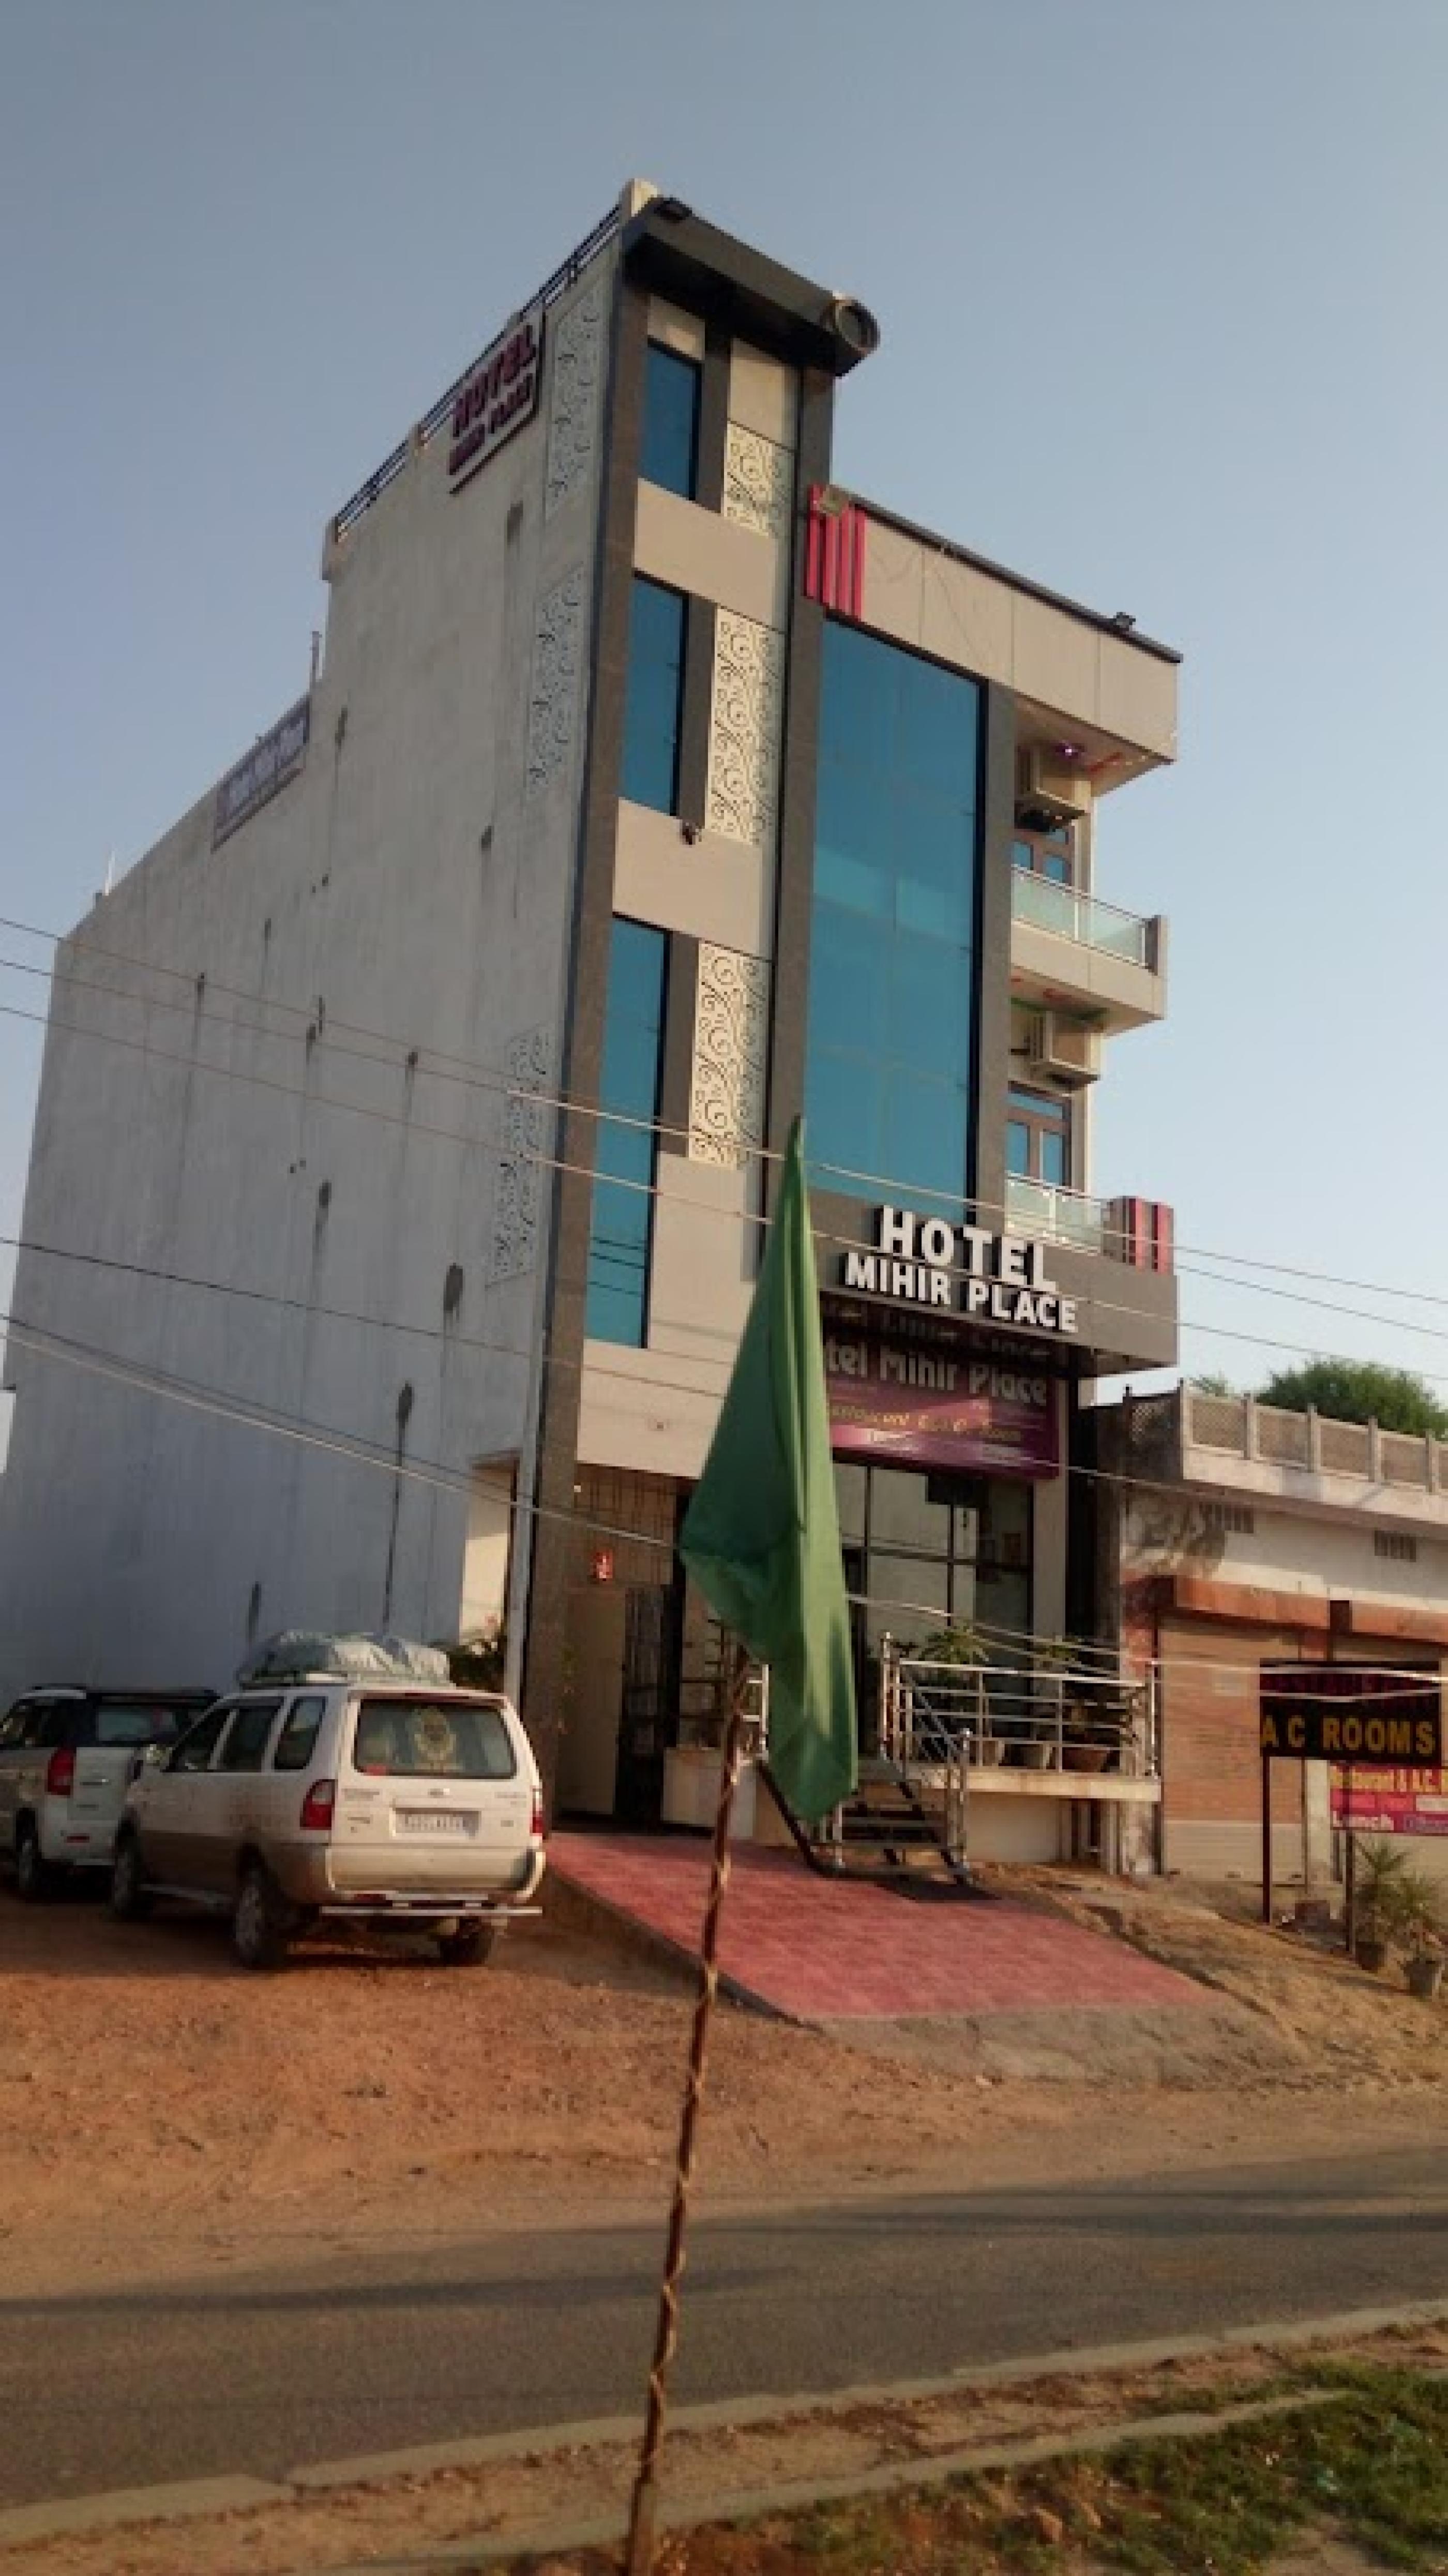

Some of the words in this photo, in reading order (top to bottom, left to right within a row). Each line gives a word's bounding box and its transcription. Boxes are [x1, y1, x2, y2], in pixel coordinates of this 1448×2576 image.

[881, 1205, 1057, 1292] HOTEL
[844, 1251, 951, 1305] MIHIR
[969, 1279, 1078, 1332] PLACE
[826, 1338, 868, 1376] tel
[880, 1348, 957, 1390] Mihir
[970, 1366, 1047, 1404] Place
[1260, 1715, 1279, 1748] A
[1287, 1715, 1305, 1748] C
[1322, 1716, 1437, 1754] ROOMS
